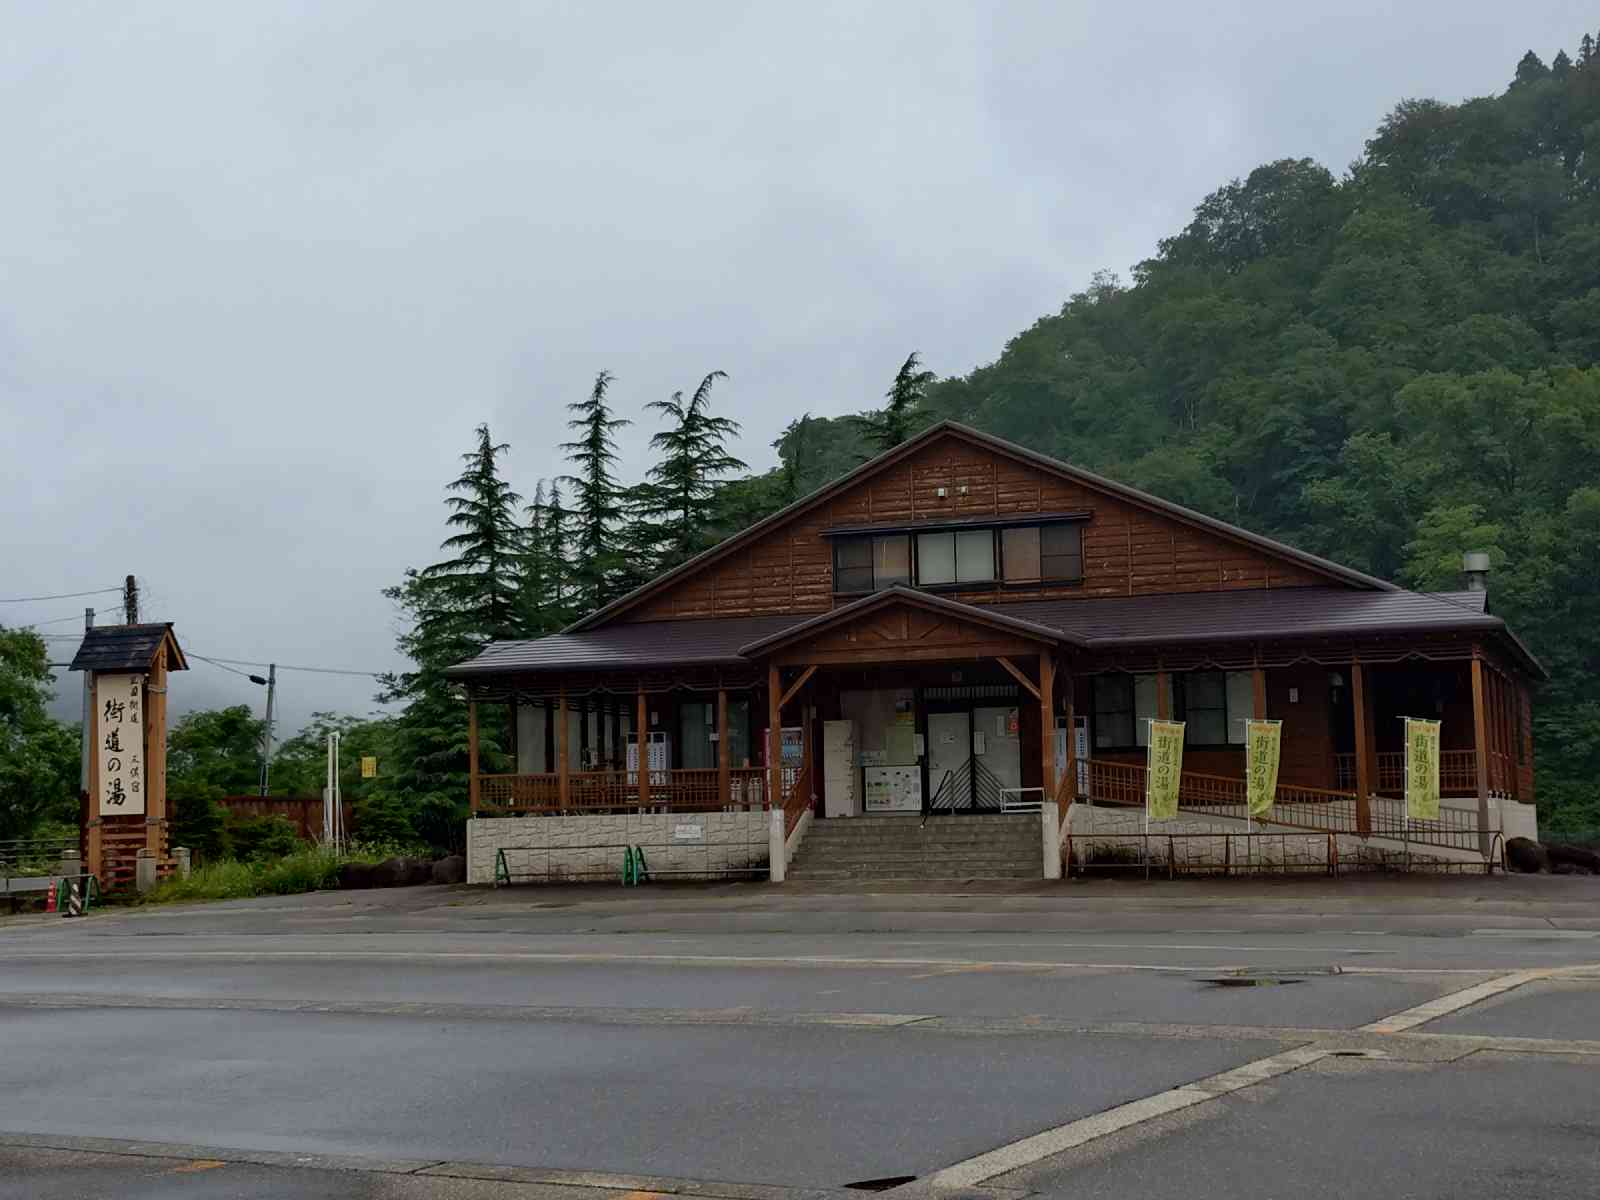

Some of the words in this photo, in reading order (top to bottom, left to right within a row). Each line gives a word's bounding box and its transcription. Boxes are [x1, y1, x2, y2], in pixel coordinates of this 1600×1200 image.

[104, 697, 126, 806] 街道の湯
[1155, 736, 1173, 790] 街道の湯
[1253, 736, 1270, 790] 街道の湯
[1414, 734, 1429, 790] 街道の湯
